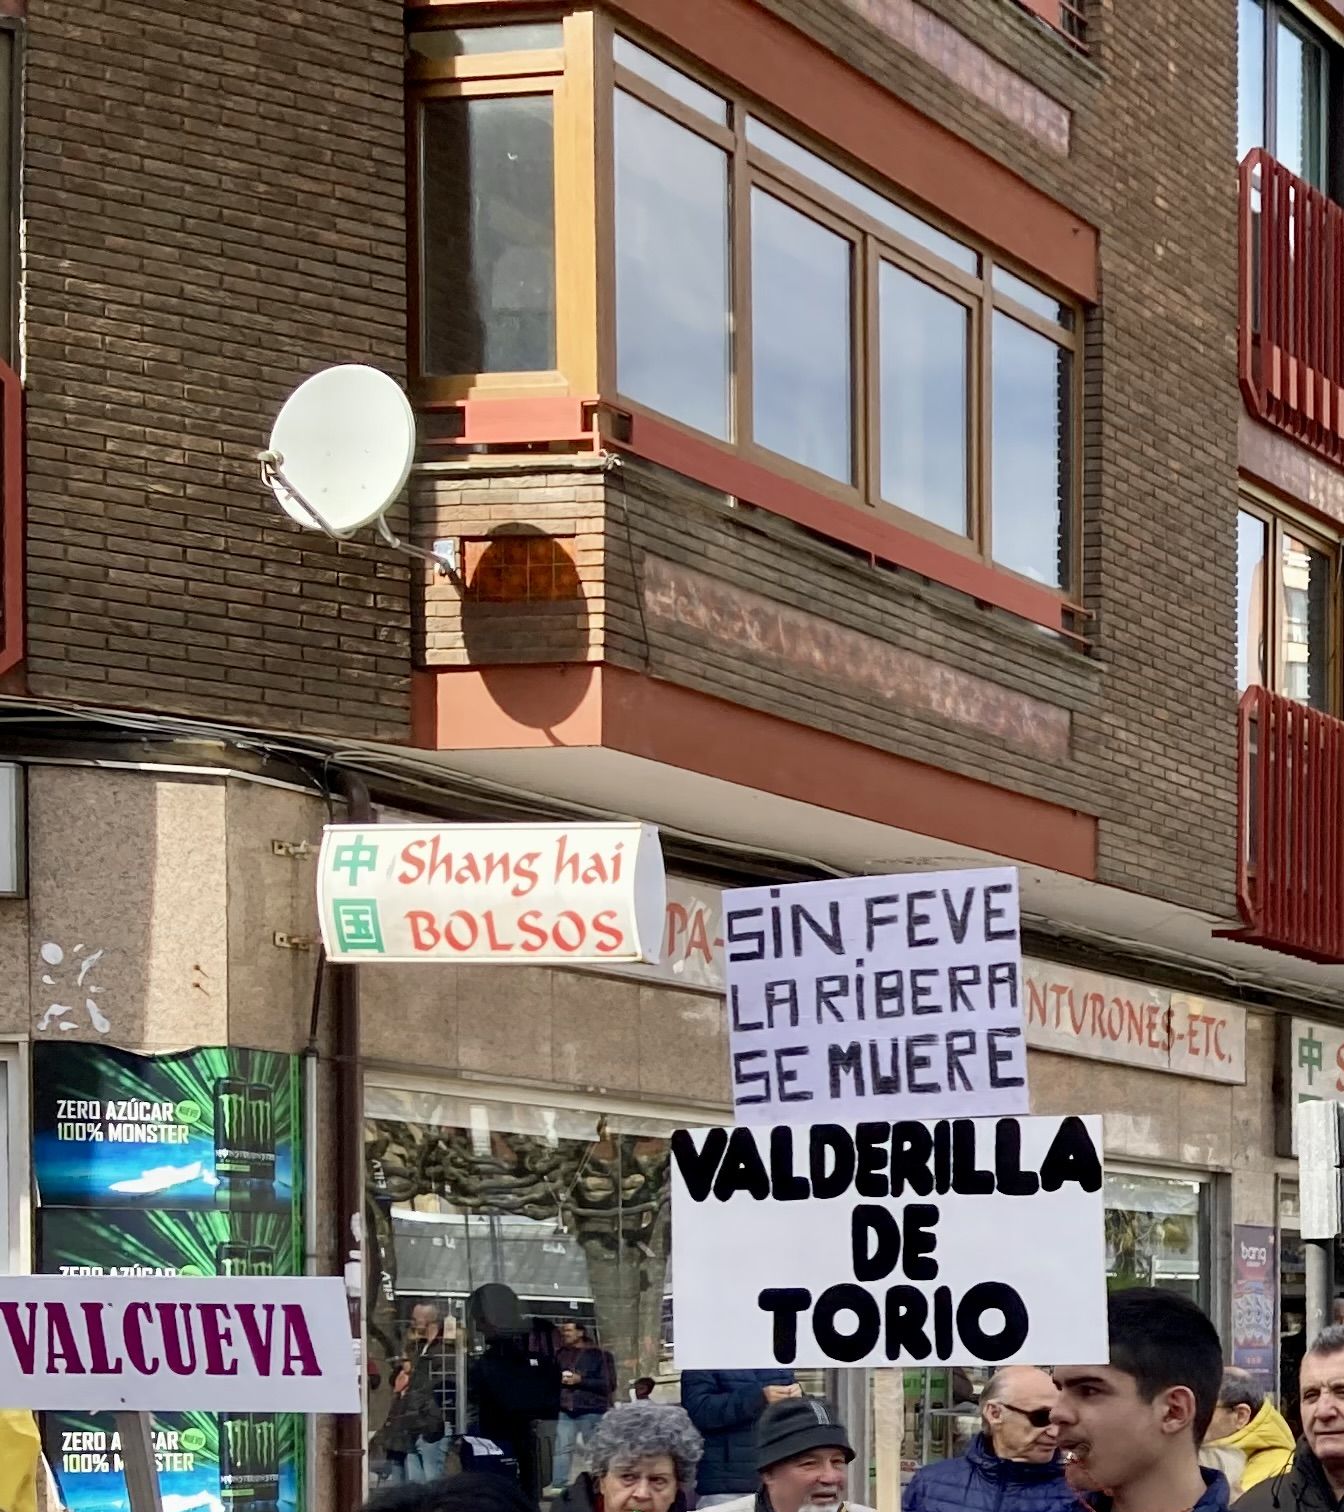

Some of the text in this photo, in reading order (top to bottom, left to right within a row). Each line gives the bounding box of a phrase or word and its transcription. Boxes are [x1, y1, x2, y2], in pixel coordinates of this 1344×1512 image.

[398, 834, 624, 896] Shang hai
[404, 909, 624, 952] BOLSOS
[866, 884, 1017, 952] FEVE
[730, 958, 1018, 1032] LA RIBERA
[734, 1027, 1025, 1105] SE MUERE
[57, 1100, 100, 1120] ZERO
[106, 1098, 174, 1122] AZÚCAR
[57, 1123, 189, 1144] 100% MONSTER
[671, 1115, 1103, 1202] VALDERILLA
[851, 1203, 939, 1282] DE
[0, 1301, 322, 1376] VALCUEVA
[757, 1280, 1029, 1364] TORIO
[62, 1431, 107, 1451] ZERO
[63, 1453, 109, 1473] 100%
